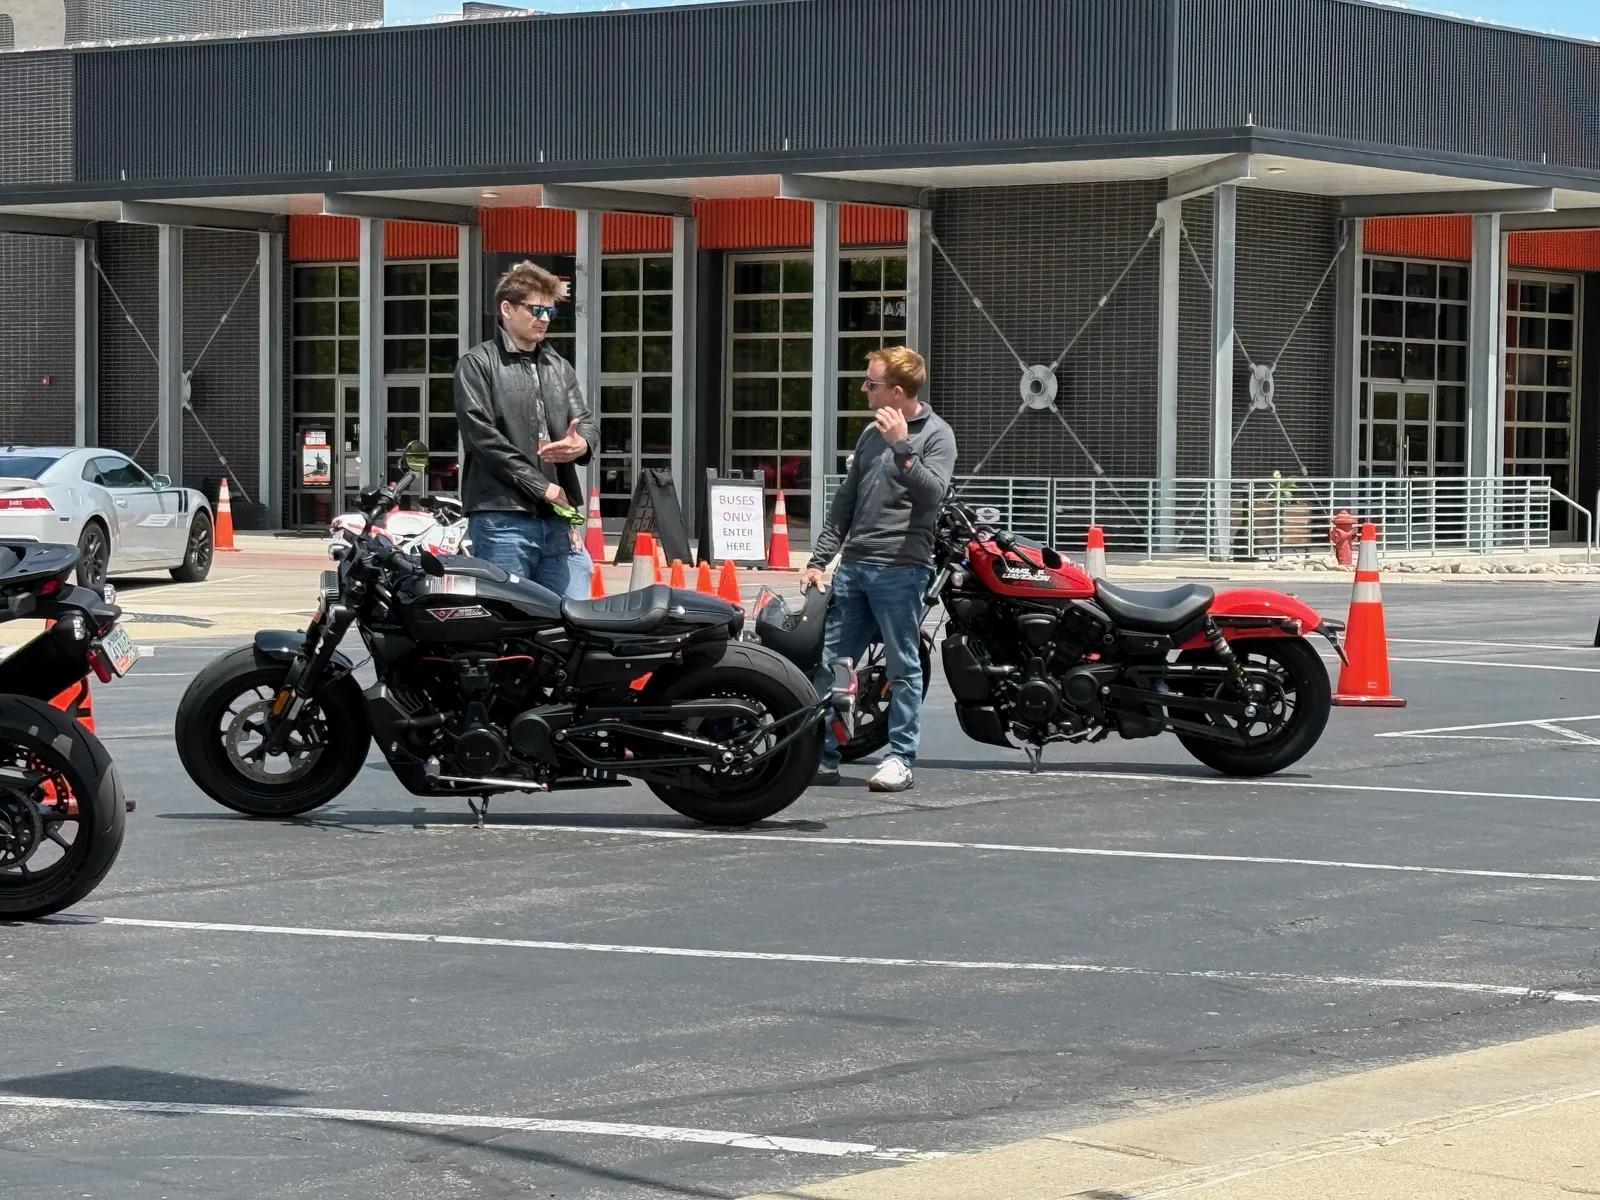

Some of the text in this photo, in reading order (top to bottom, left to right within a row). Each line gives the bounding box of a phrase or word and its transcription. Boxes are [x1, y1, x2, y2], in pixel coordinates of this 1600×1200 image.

[719, 495, 755, 506] BUSES
[722, 511, 753, 522] ONLY
[722, 527, 753, 537] ENTER
[726, 541, 752, 551] HERE
